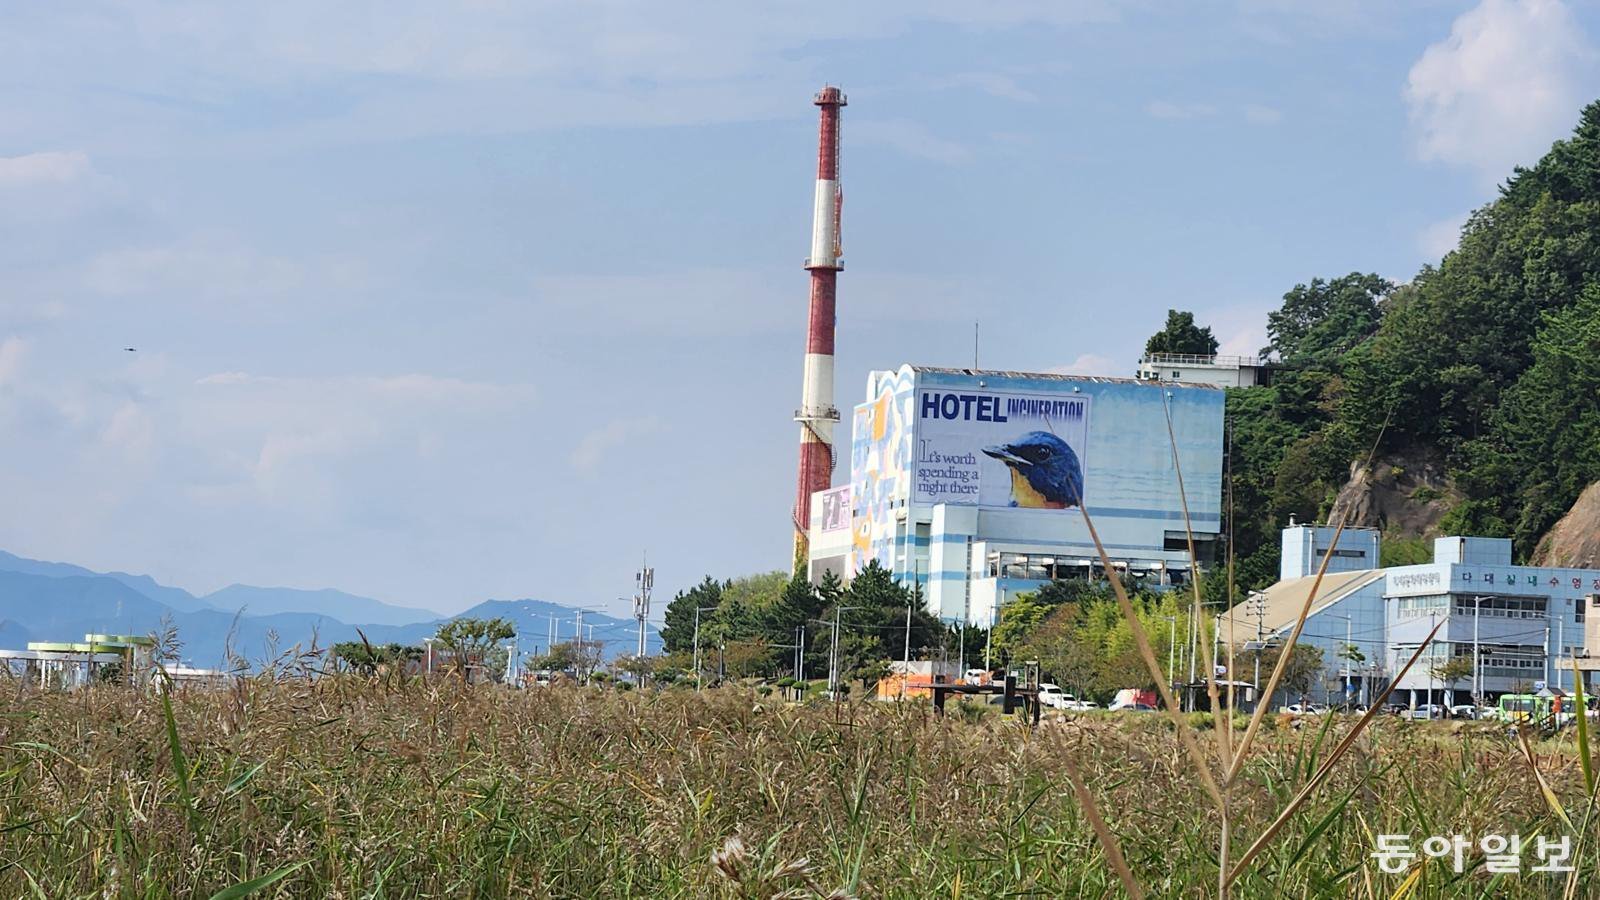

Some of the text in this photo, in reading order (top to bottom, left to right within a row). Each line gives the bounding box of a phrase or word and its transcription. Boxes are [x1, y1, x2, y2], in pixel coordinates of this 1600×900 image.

[922, 393, 1083, 422] HOTEL INCINERATION
[943, 452, 976, 465] worth
[918, 466, 979, 483] spending a
[918, 480, 979, 496] night there
